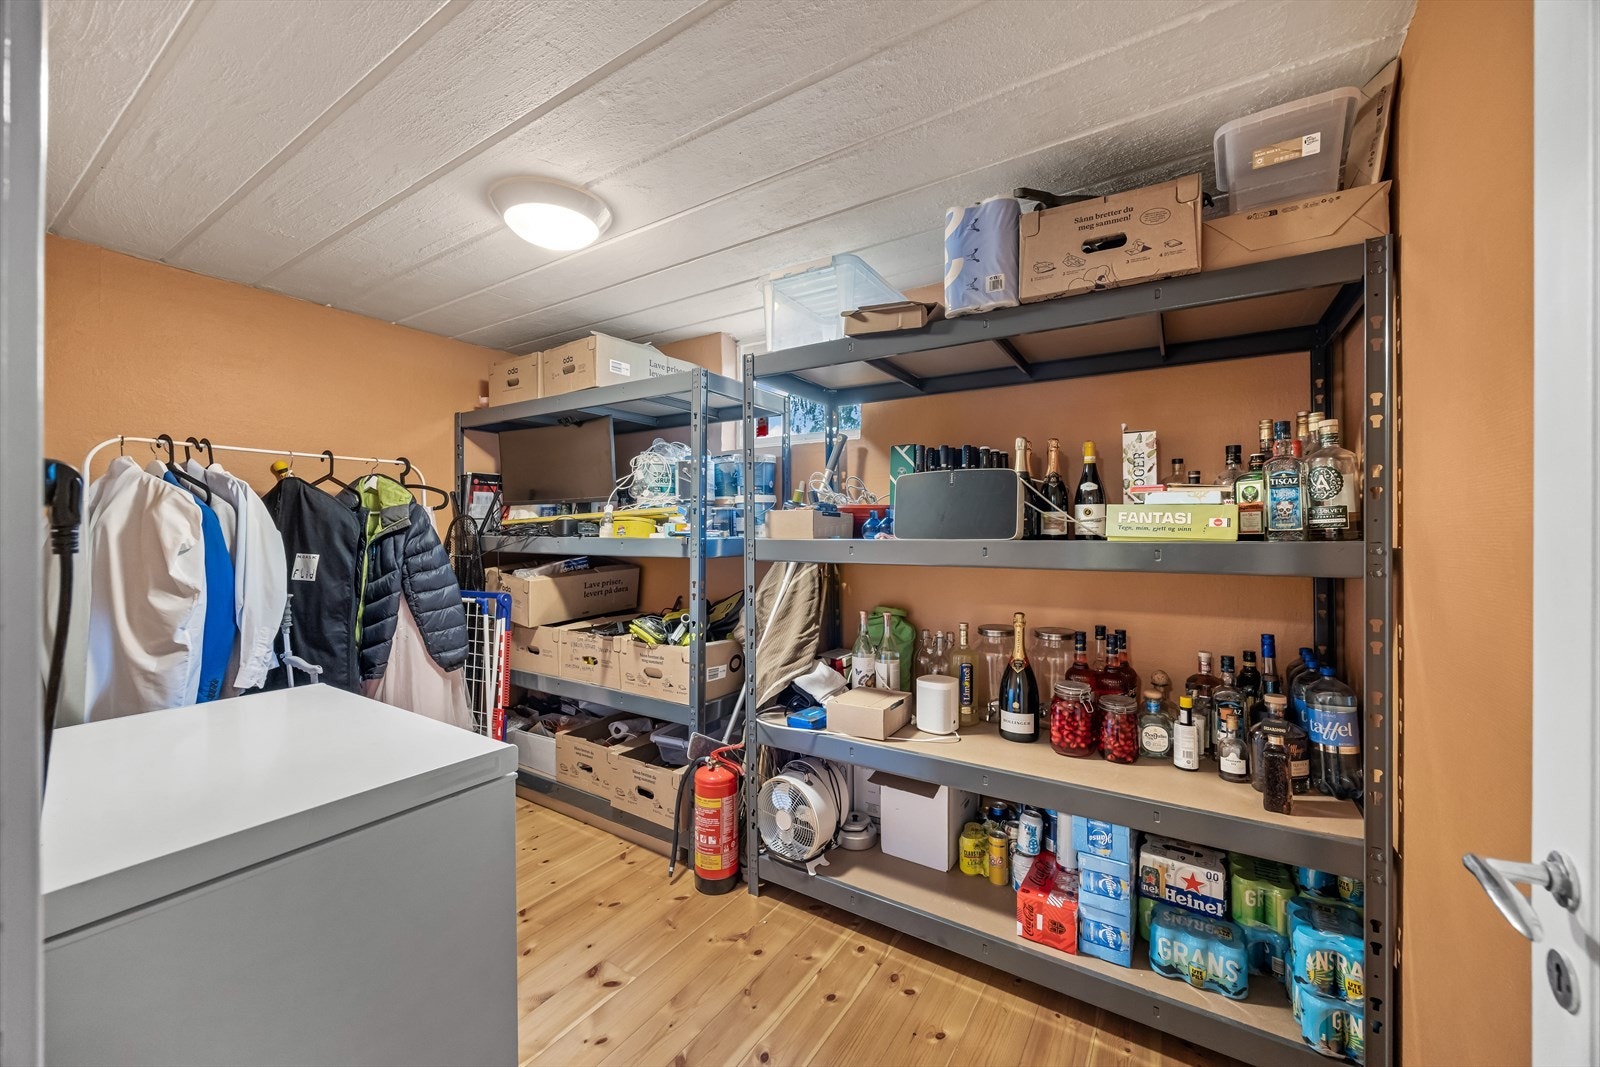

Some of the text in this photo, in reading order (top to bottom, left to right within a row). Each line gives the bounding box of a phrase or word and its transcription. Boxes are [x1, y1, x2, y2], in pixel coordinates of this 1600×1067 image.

[1073, 206, 1134, 225] Sånn bretter du
[1078, 223, 1095, 231] meg
[1095, 214, 1132, 228] sammen!
[562, 355, 574, 364] oda
[649, 359, 666, 371] Lave
[507, 367, 519, 375] oda
[1270, 477, 1298, 486] TISCAZ
[1118, 511, 1192, 525] FANTASI
[584, 578, 624, 589] Lave priser,
[583, 585, 629, 598] levert på døra
[1309, 718, 1353, 741] taffel
[1158, 937, 1239, 983] GRANS
[1347, 981, 1362, 990] UTE
[1347, 986, 1363, 996] PILS
